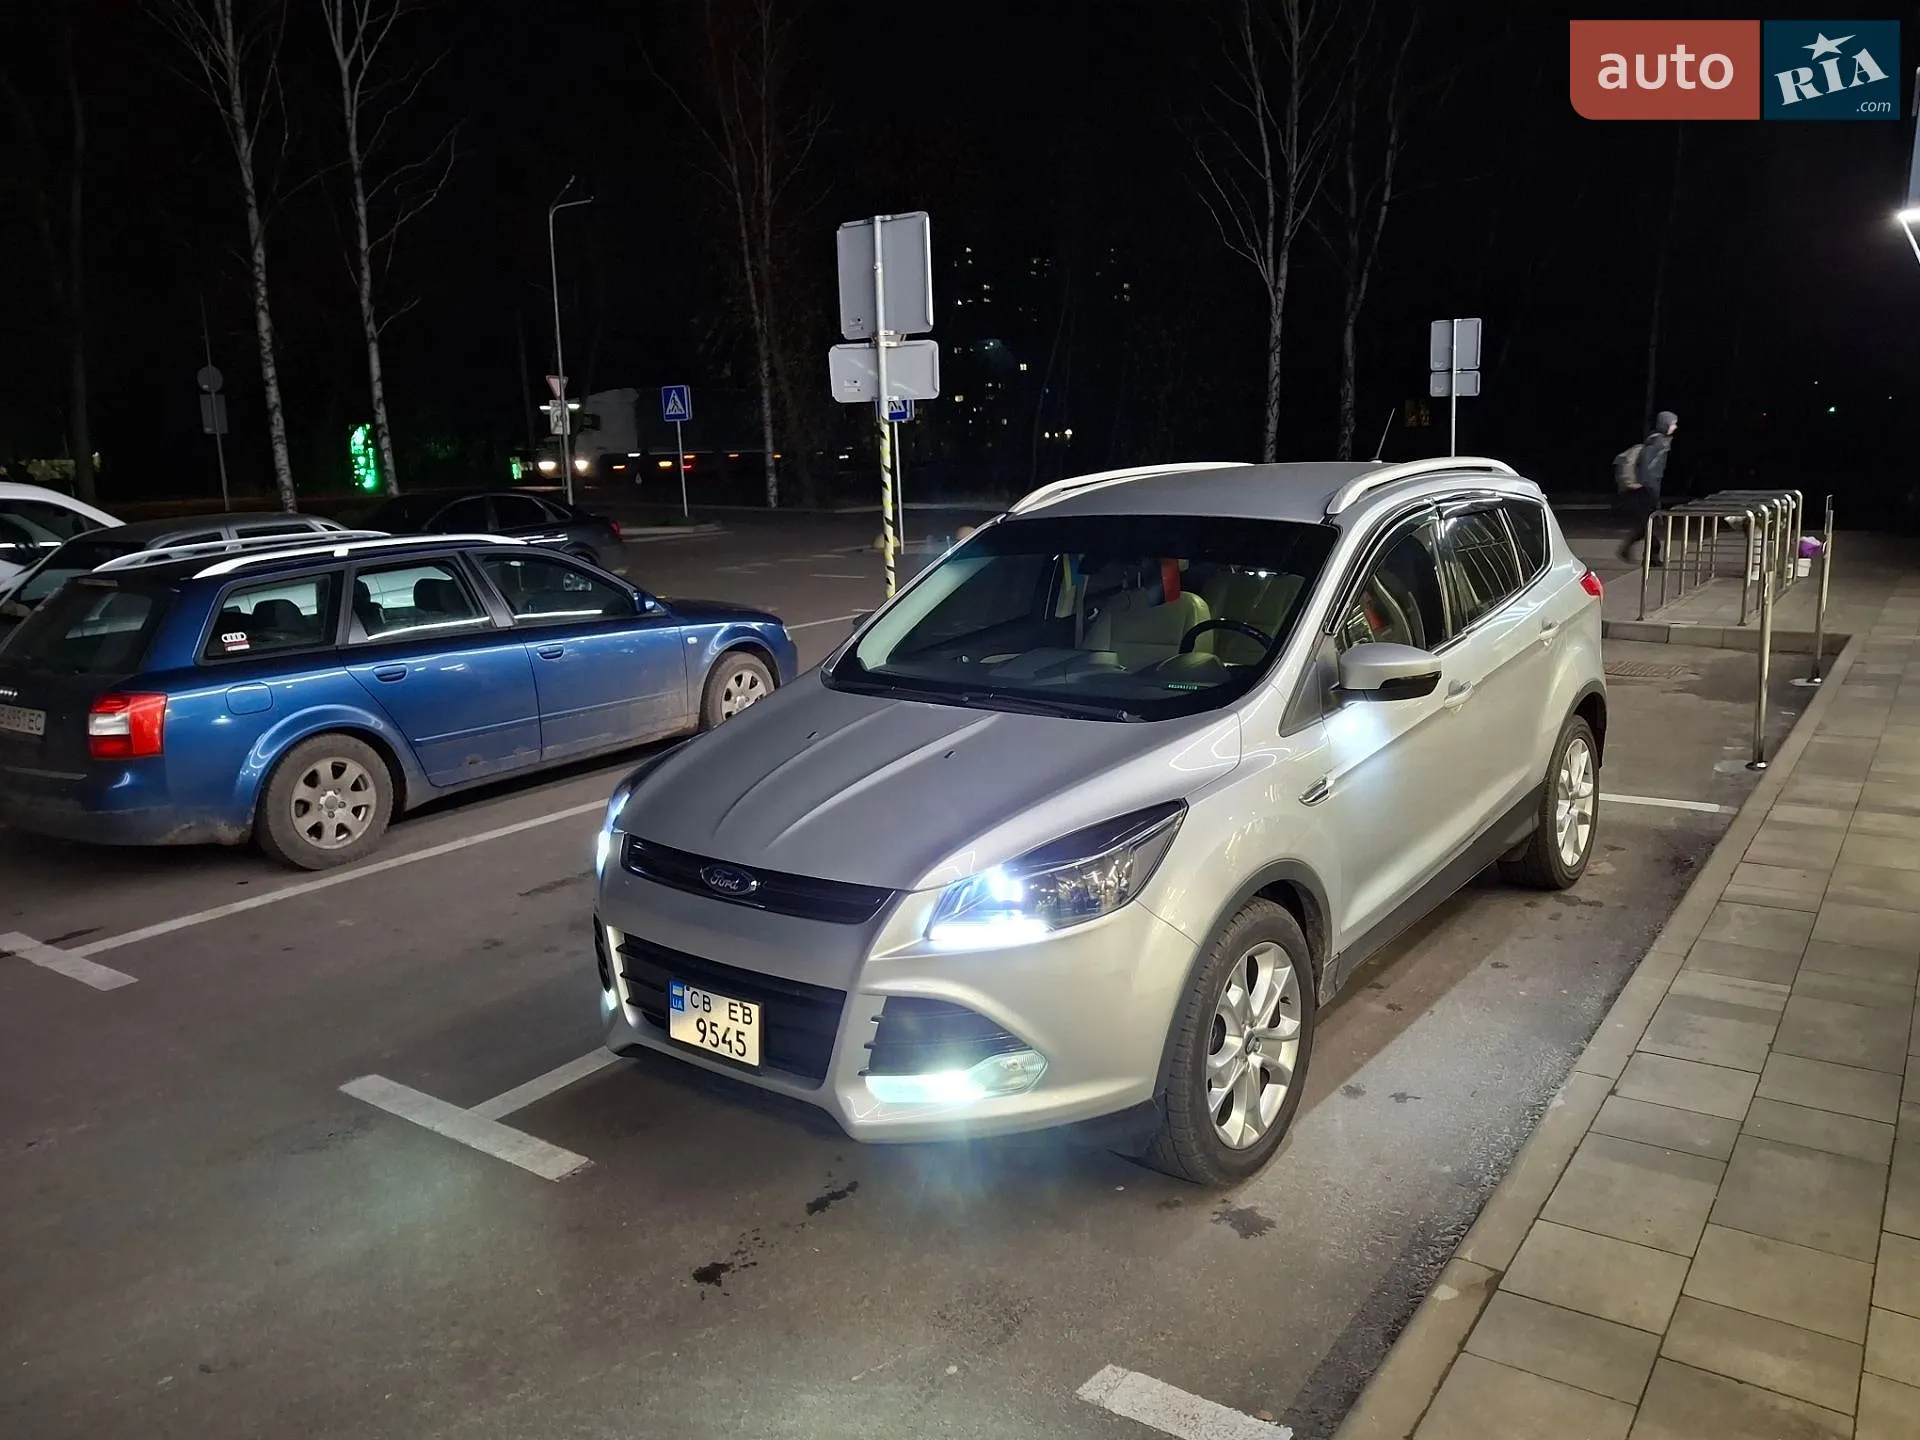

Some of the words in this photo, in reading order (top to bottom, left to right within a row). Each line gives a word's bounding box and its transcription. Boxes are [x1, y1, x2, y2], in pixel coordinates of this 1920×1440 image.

[710, 868, 740, 890] Ford
[672, 998, 684, 1010] UA
[690, 991, 712, 1013] CB
[728, 1002, 753, 1026] EB
[696, 1018, 747, 1057] 9545
